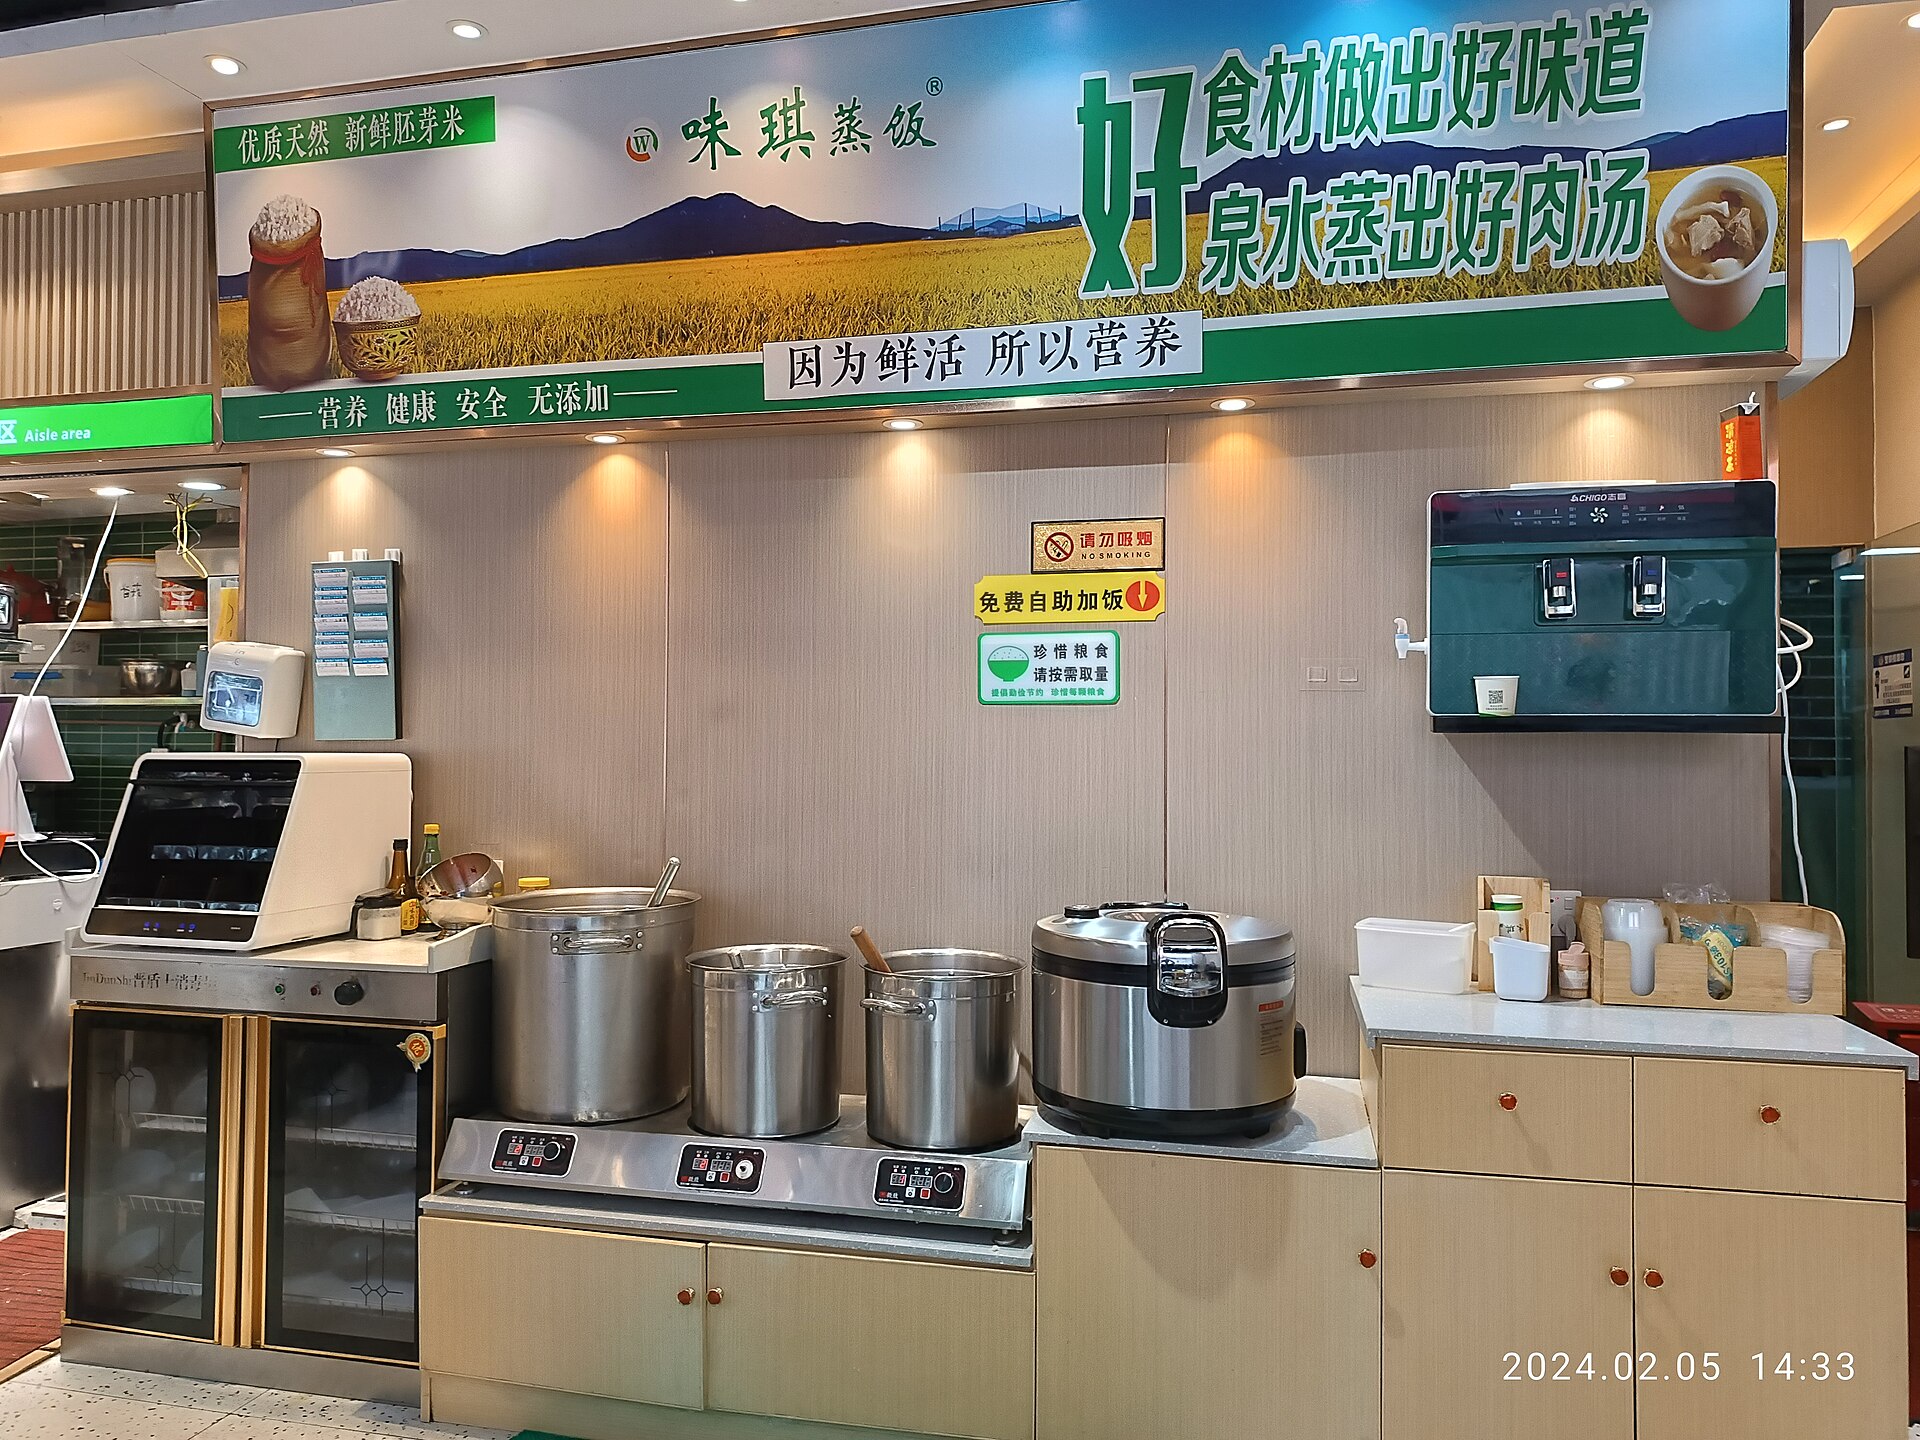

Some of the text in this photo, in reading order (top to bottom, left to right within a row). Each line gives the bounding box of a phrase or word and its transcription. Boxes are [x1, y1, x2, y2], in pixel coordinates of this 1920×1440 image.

[1203, 7, 1650, 158] 食材做出好味道
[238, 104, 466, 164] 优质天然 新鲜胚芽米
[681, 86, 938, 170] 味琪蒸饭
[1076, 70, 1199, 294] 好
[1203, 153, 1650, 290] 泉水蒸出好肉汤
[788, 316, 1183, 389] 因为鲜活 所以营养
[317, 381, 609, 429] 营养 健康 安全 无添加
[24, 428, 91, 443] Aisle area
[1080, 531, 1152, 548] 请勿吸烟
[1099, 551, 1151, 560] SMOKING
[979, 589, 1124, 613] 免费自助加饭
[1033, 643, 1109, 659] 珍惜粮食
[1033, 666, 1109, 682] 请按需取量
